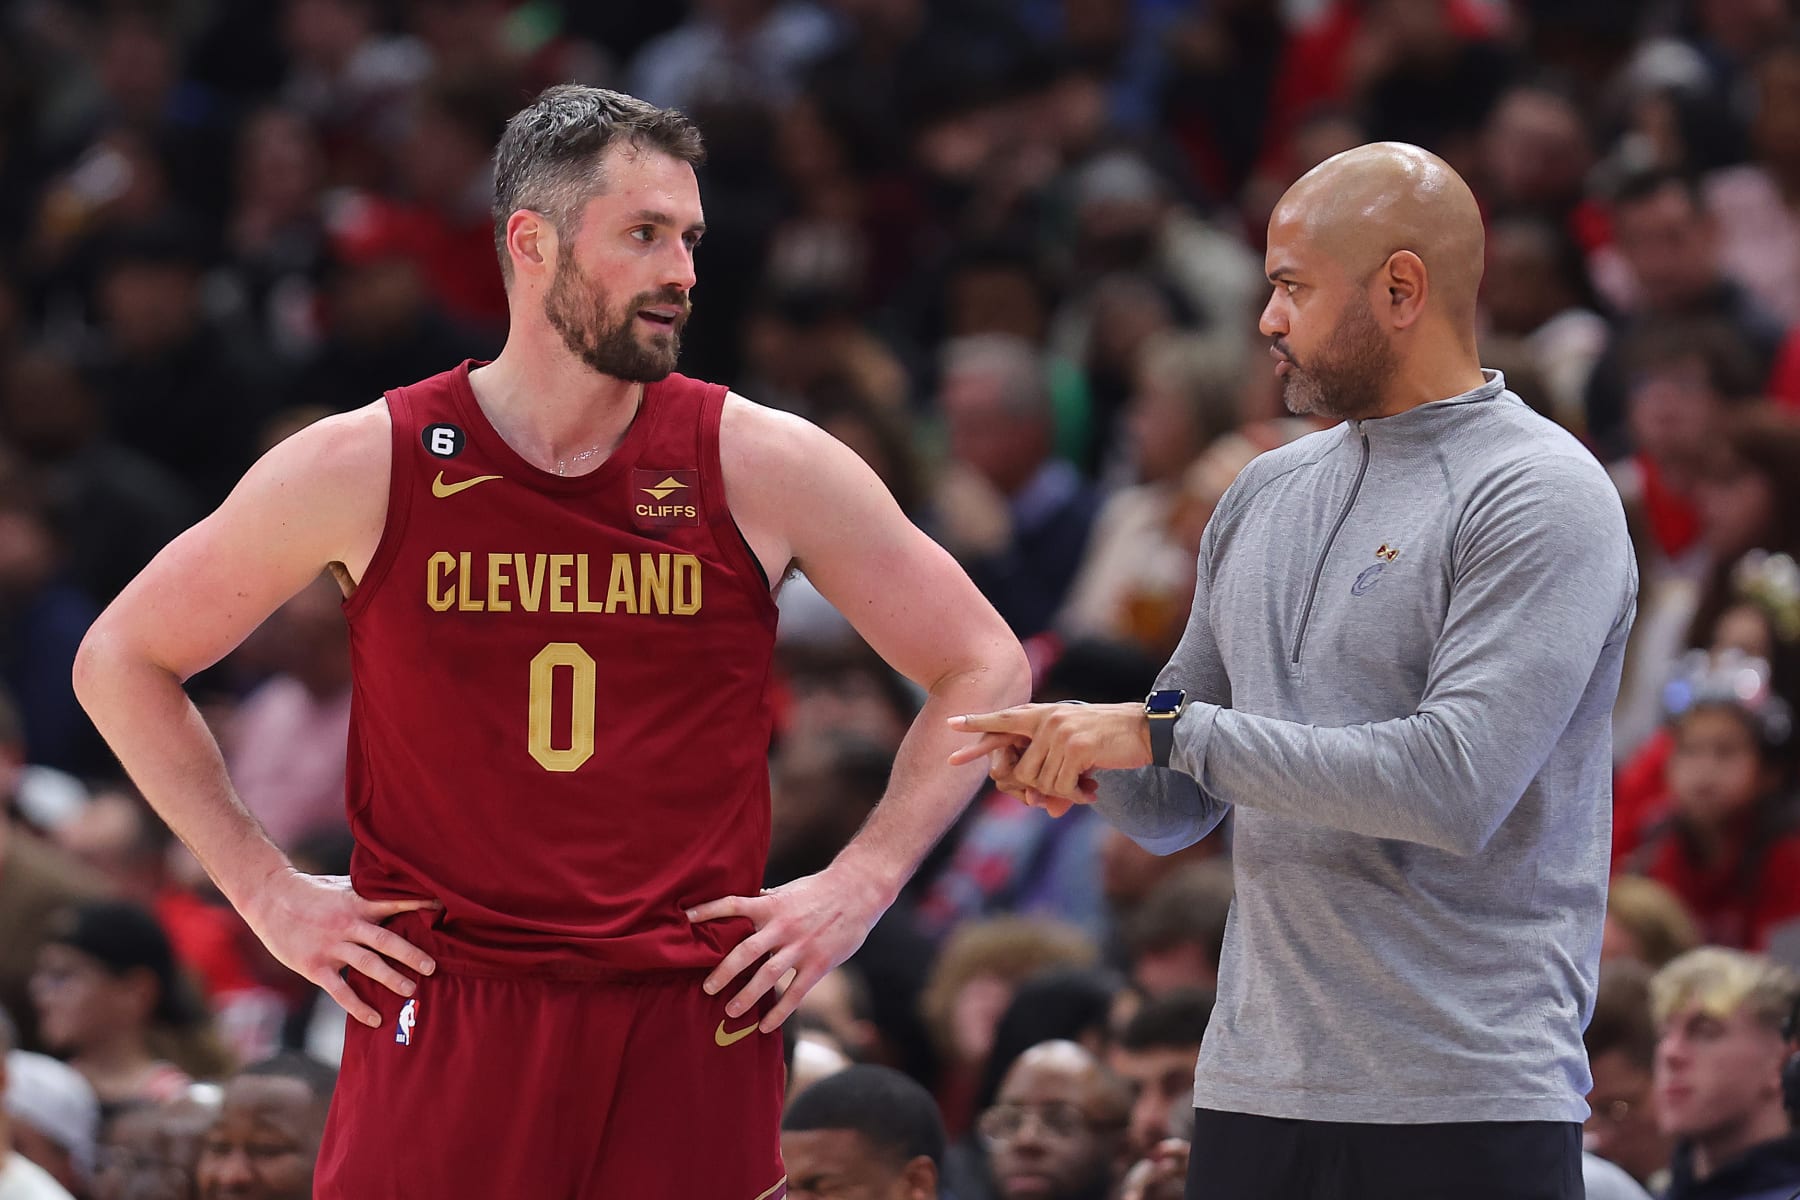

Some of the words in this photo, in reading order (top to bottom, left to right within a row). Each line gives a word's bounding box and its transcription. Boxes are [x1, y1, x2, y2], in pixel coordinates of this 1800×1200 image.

[431, 427, 455, 455] 6
[635, 504, 696, 518] CLIFFS
[427, 551, 702, 616] CLEVELAND
[528, 642, 596, 773] 0
